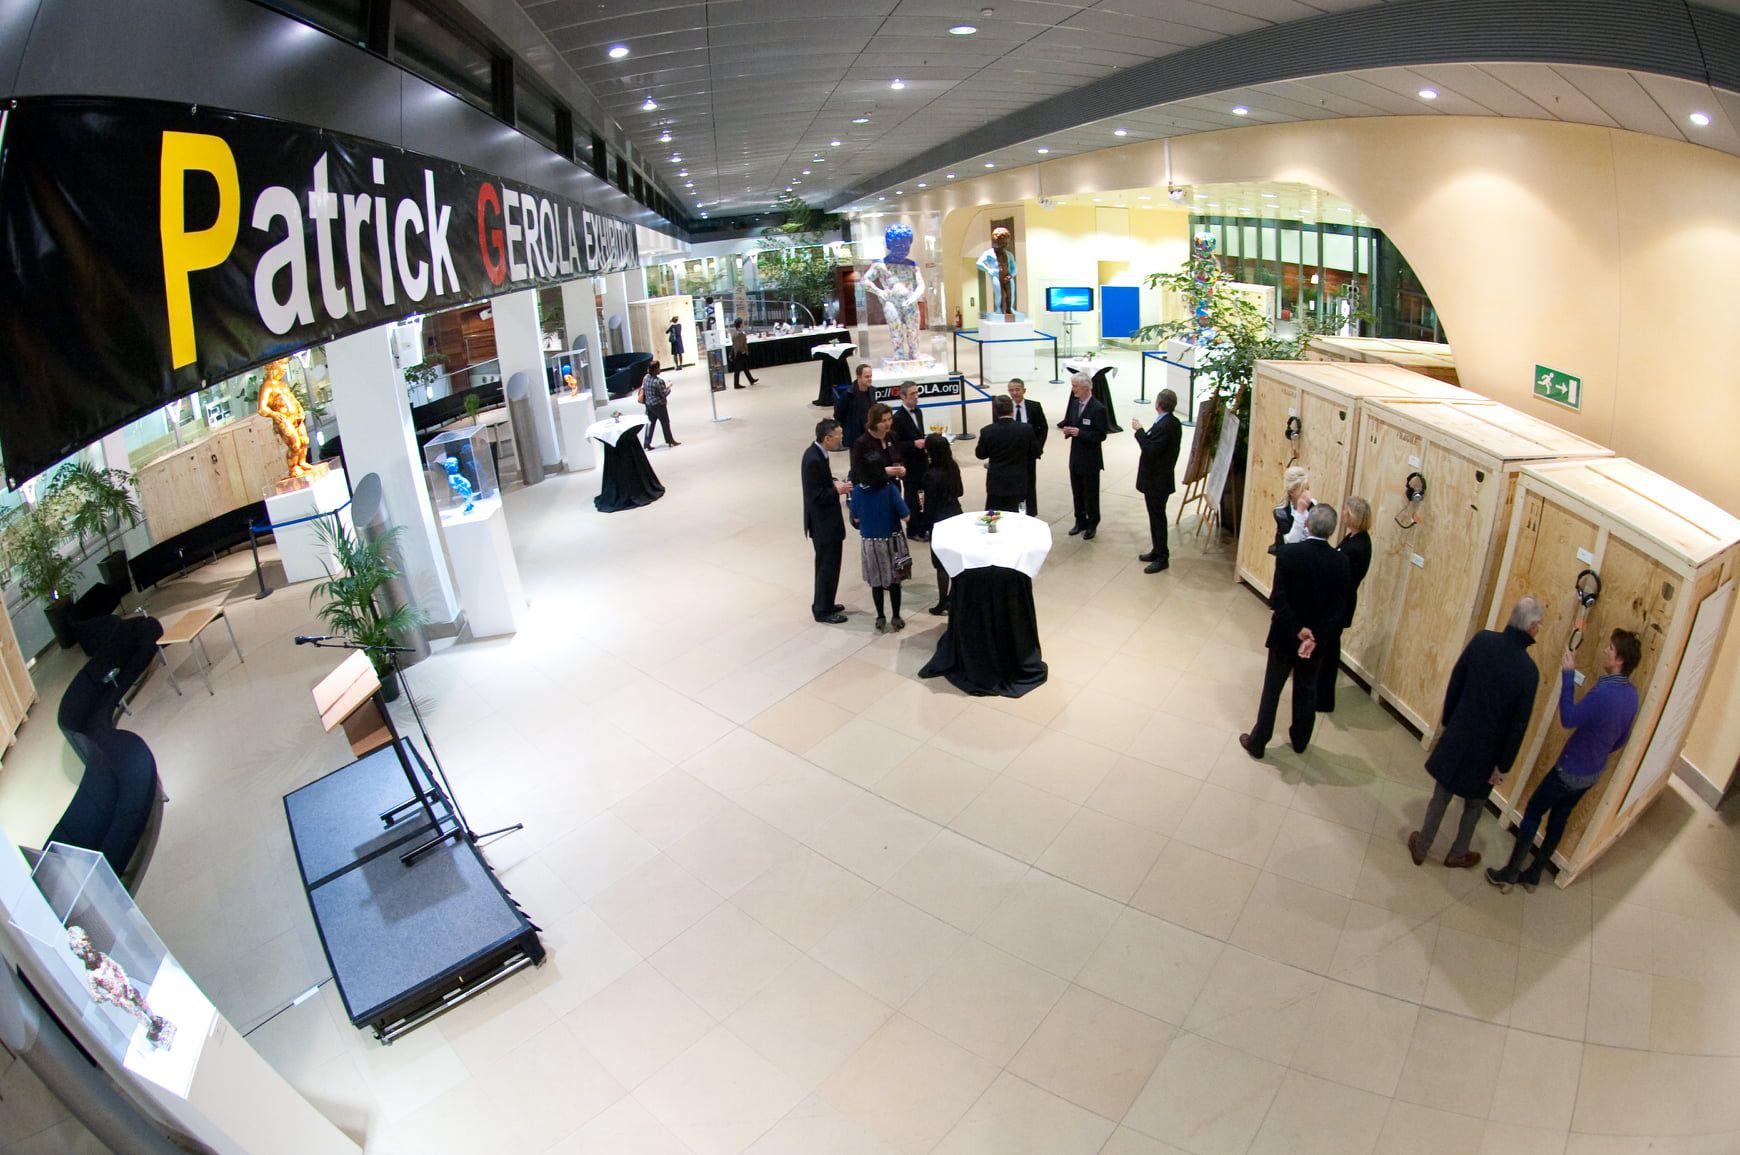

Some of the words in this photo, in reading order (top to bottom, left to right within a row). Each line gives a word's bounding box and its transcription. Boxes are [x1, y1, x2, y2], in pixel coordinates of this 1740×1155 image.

[160, 130, 461, 370] Patrick
[477, 182, 582, 286] GEROLA
[582, 210, 638, 271] EXHIBITION
[874, 383, 959, 400] p://GOLA.org
